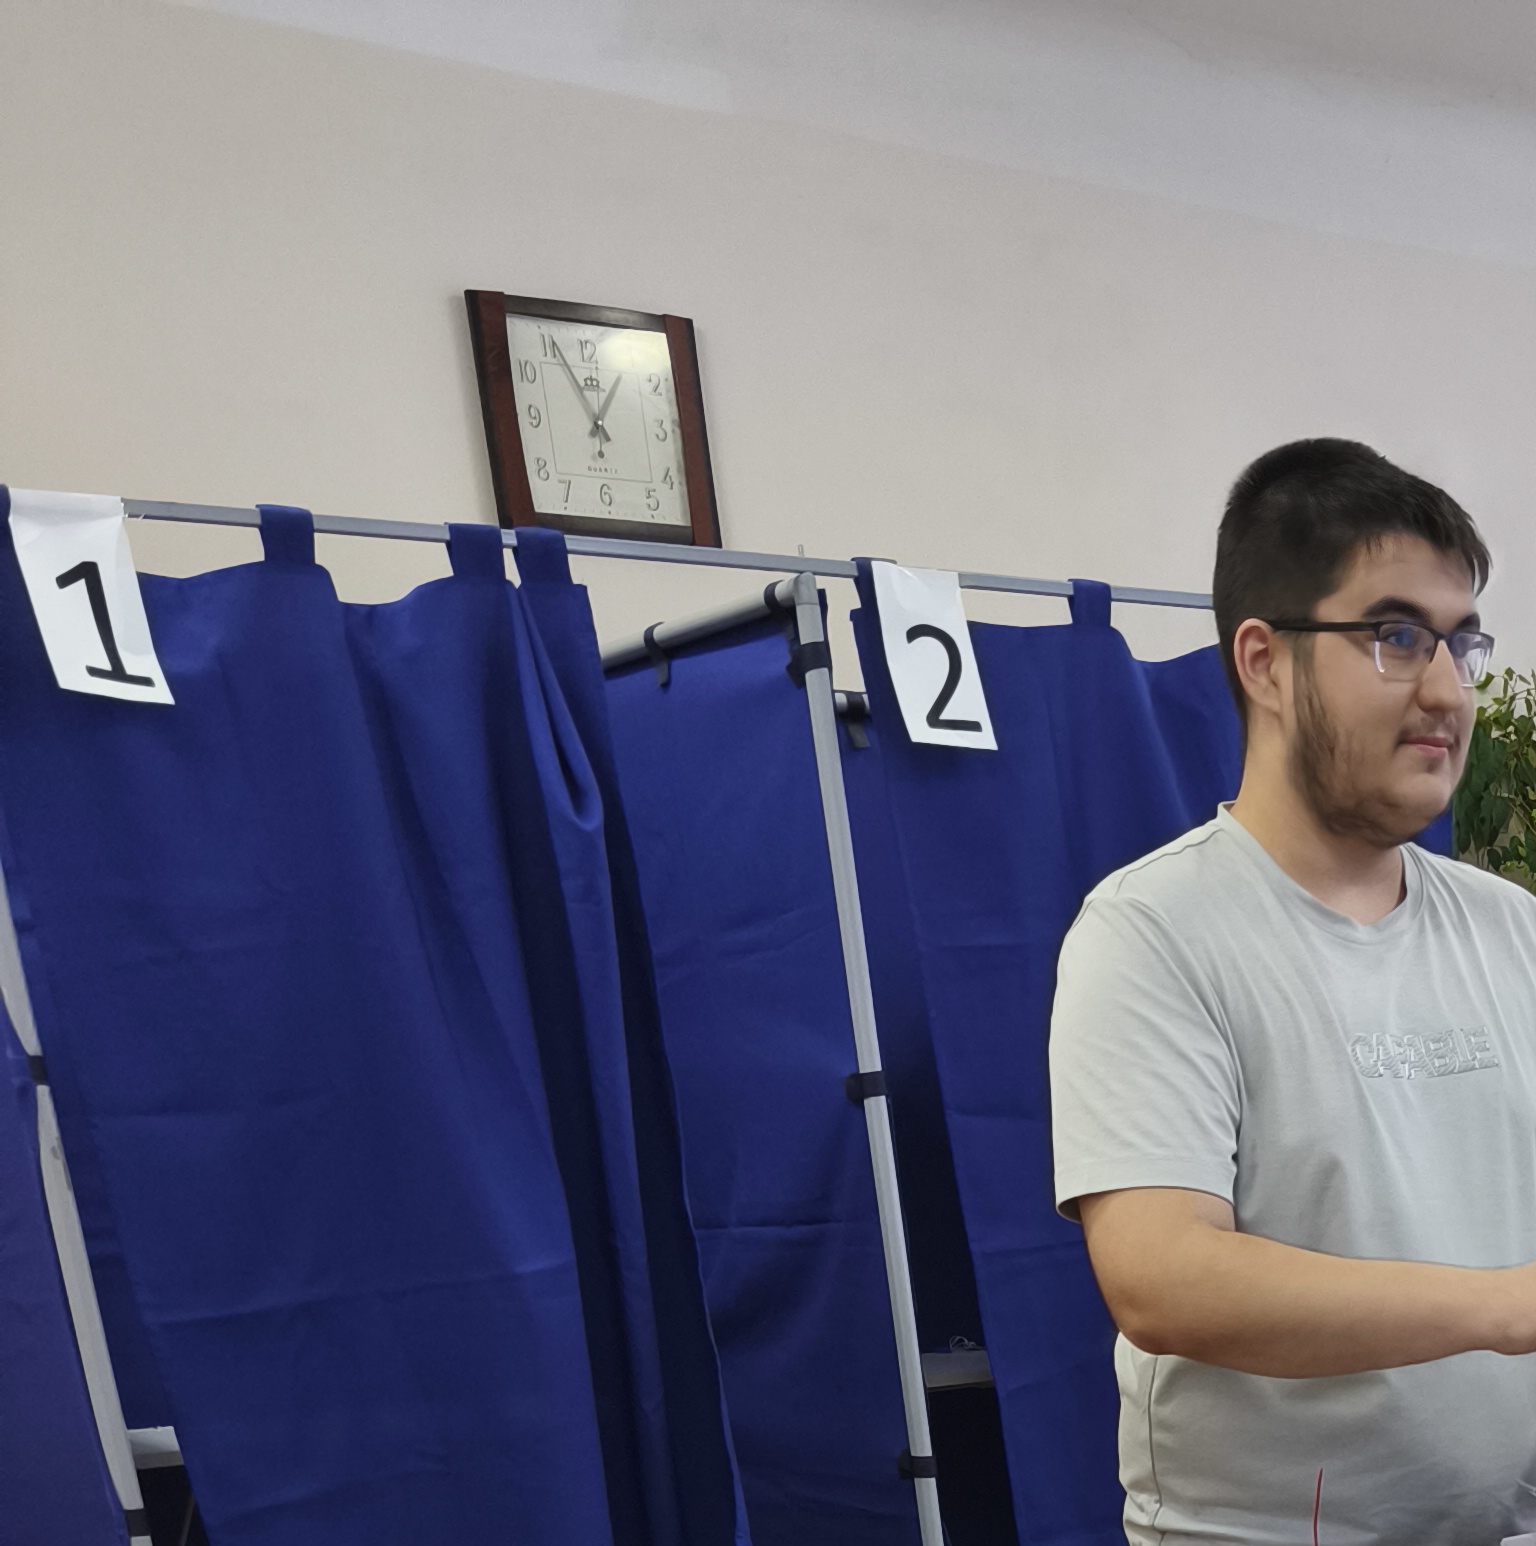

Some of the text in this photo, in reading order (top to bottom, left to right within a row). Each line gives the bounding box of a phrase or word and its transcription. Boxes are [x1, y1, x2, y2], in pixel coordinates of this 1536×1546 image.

[577, 337, 598, 364] 12
[517, 357, 663, 397] 10 2
[527, 403, 668, 443] 9 3
[535, 456, 675, 491] 8 4
[557, 478, 660, 512] 7 6 5
[55, 560, 156, 688] 1
[905, 623, 983, 732] 2
